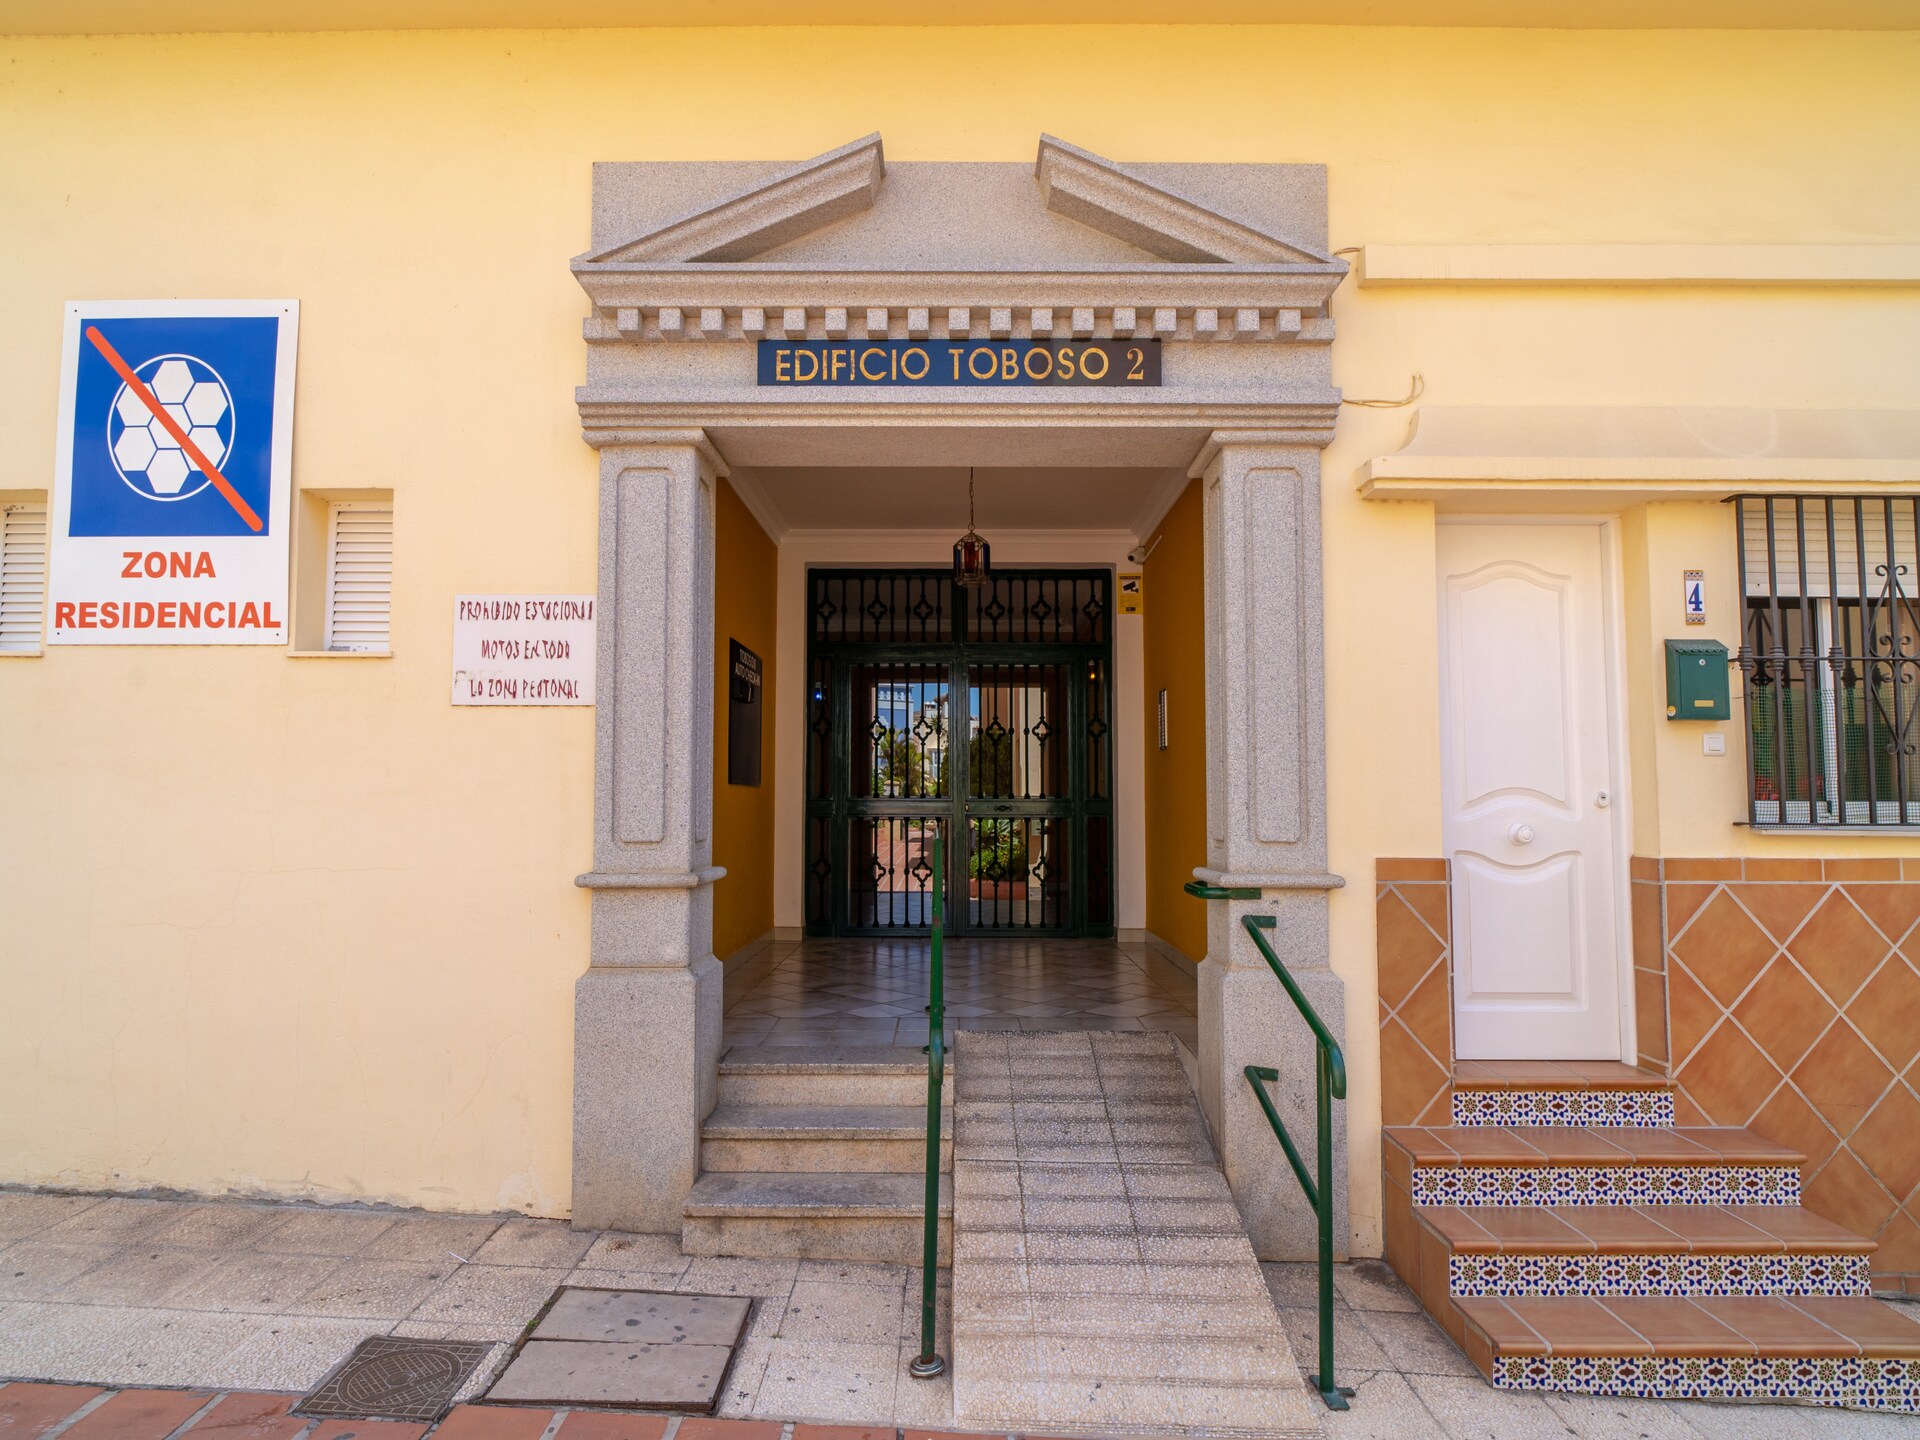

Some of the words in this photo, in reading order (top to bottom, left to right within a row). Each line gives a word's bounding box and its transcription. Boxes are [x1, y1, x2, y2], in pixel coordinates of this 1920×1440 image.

[775, 347, 931, 382] EDIFICIO
[949, 347, 1110, 381] TOBOSO
[1126, 347, 1144, 381] 2
[121, 551, 216, 579] ZONA
[1688, 583, 1704, 612] 4
[55, 601, 282, 629] RESIDENCIAL
[481, 639, 520, 660] MOTOS
